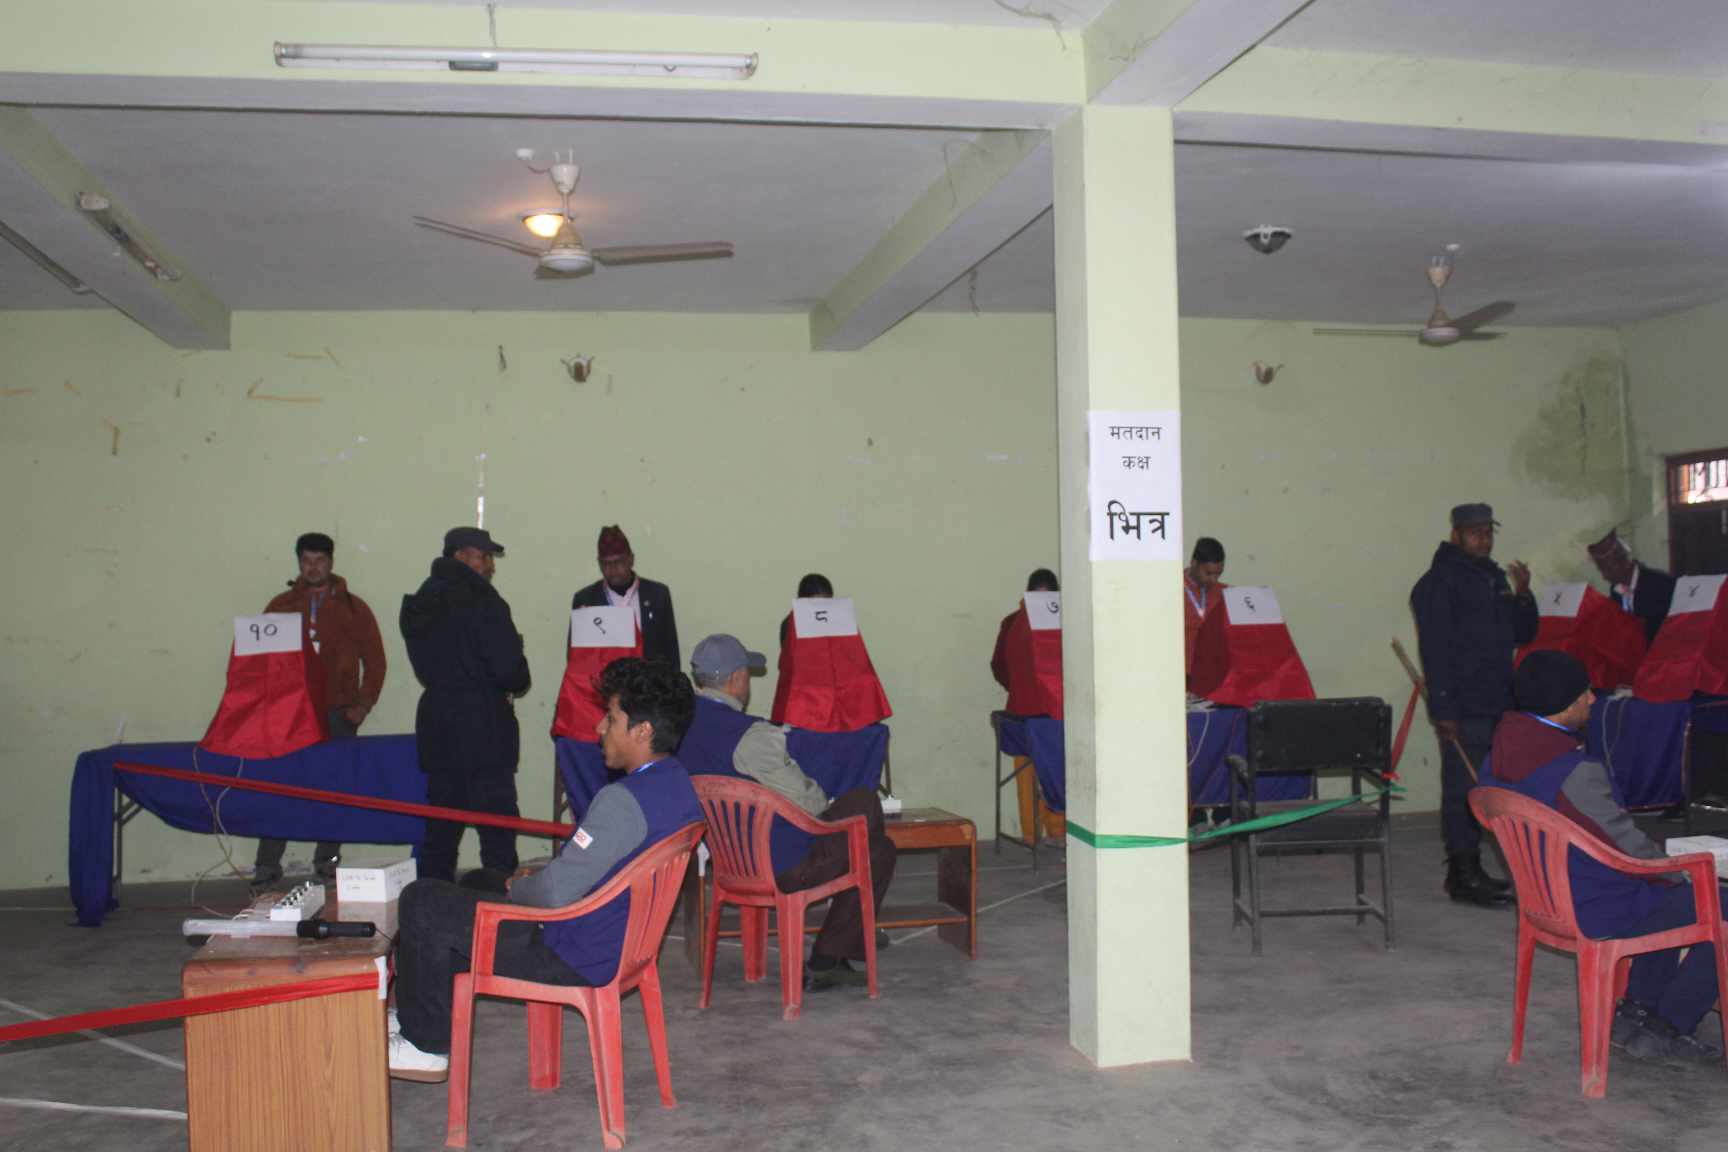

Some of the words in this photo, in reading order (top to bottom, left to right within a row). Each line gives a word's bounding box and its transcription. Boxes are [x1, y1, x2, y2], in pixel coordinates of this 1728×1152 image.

[1108, 426, 1162, 440] मतदान
[1122, 456, 1151, 470] कक्ष
[1107, 500, 1170, 540] भित्र
[815, 610, 828, 622] ८
[249, 623, 278, 641] १०
